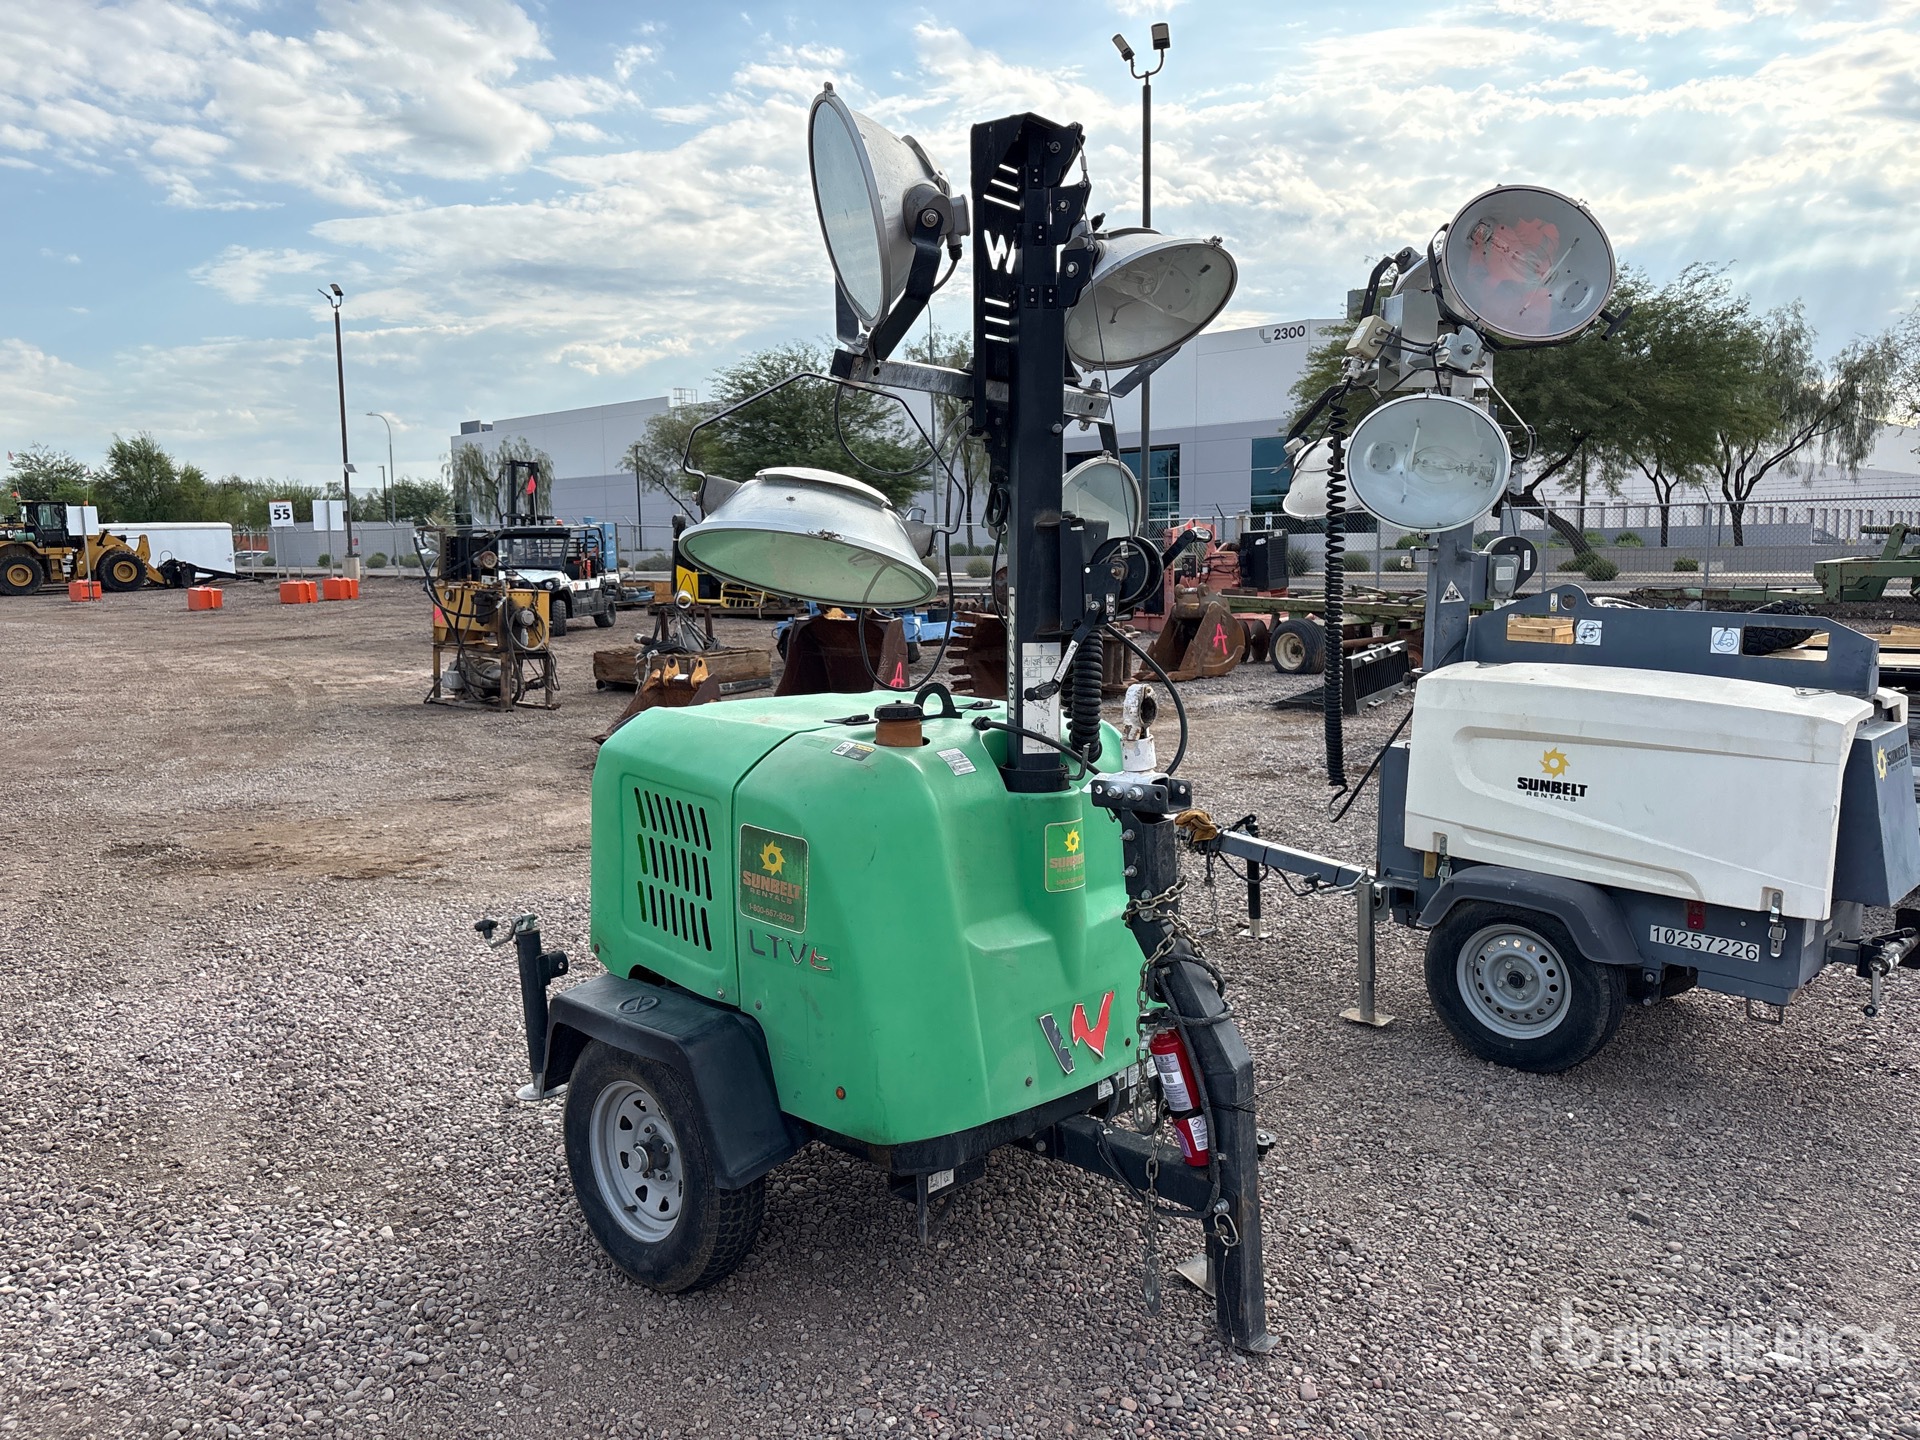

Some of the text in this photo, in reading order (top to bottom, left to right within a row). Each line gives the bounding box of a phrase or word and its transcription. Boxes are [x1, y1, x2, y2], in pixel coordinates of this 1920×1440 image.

[1274, 325, 1306, 340] 2300
[274, 509, 291, 520] 55
[1213, 623, 1228, 655] A
[1517, 776, 1588, 797] SUNBELT
[1526, 790, 1577, 802] RENTALS
[742, 870, 802, 899] SUNBELT
[750, 888, 793, 904] RENTALS
[1652, 925, 1759, 961] 10257226
